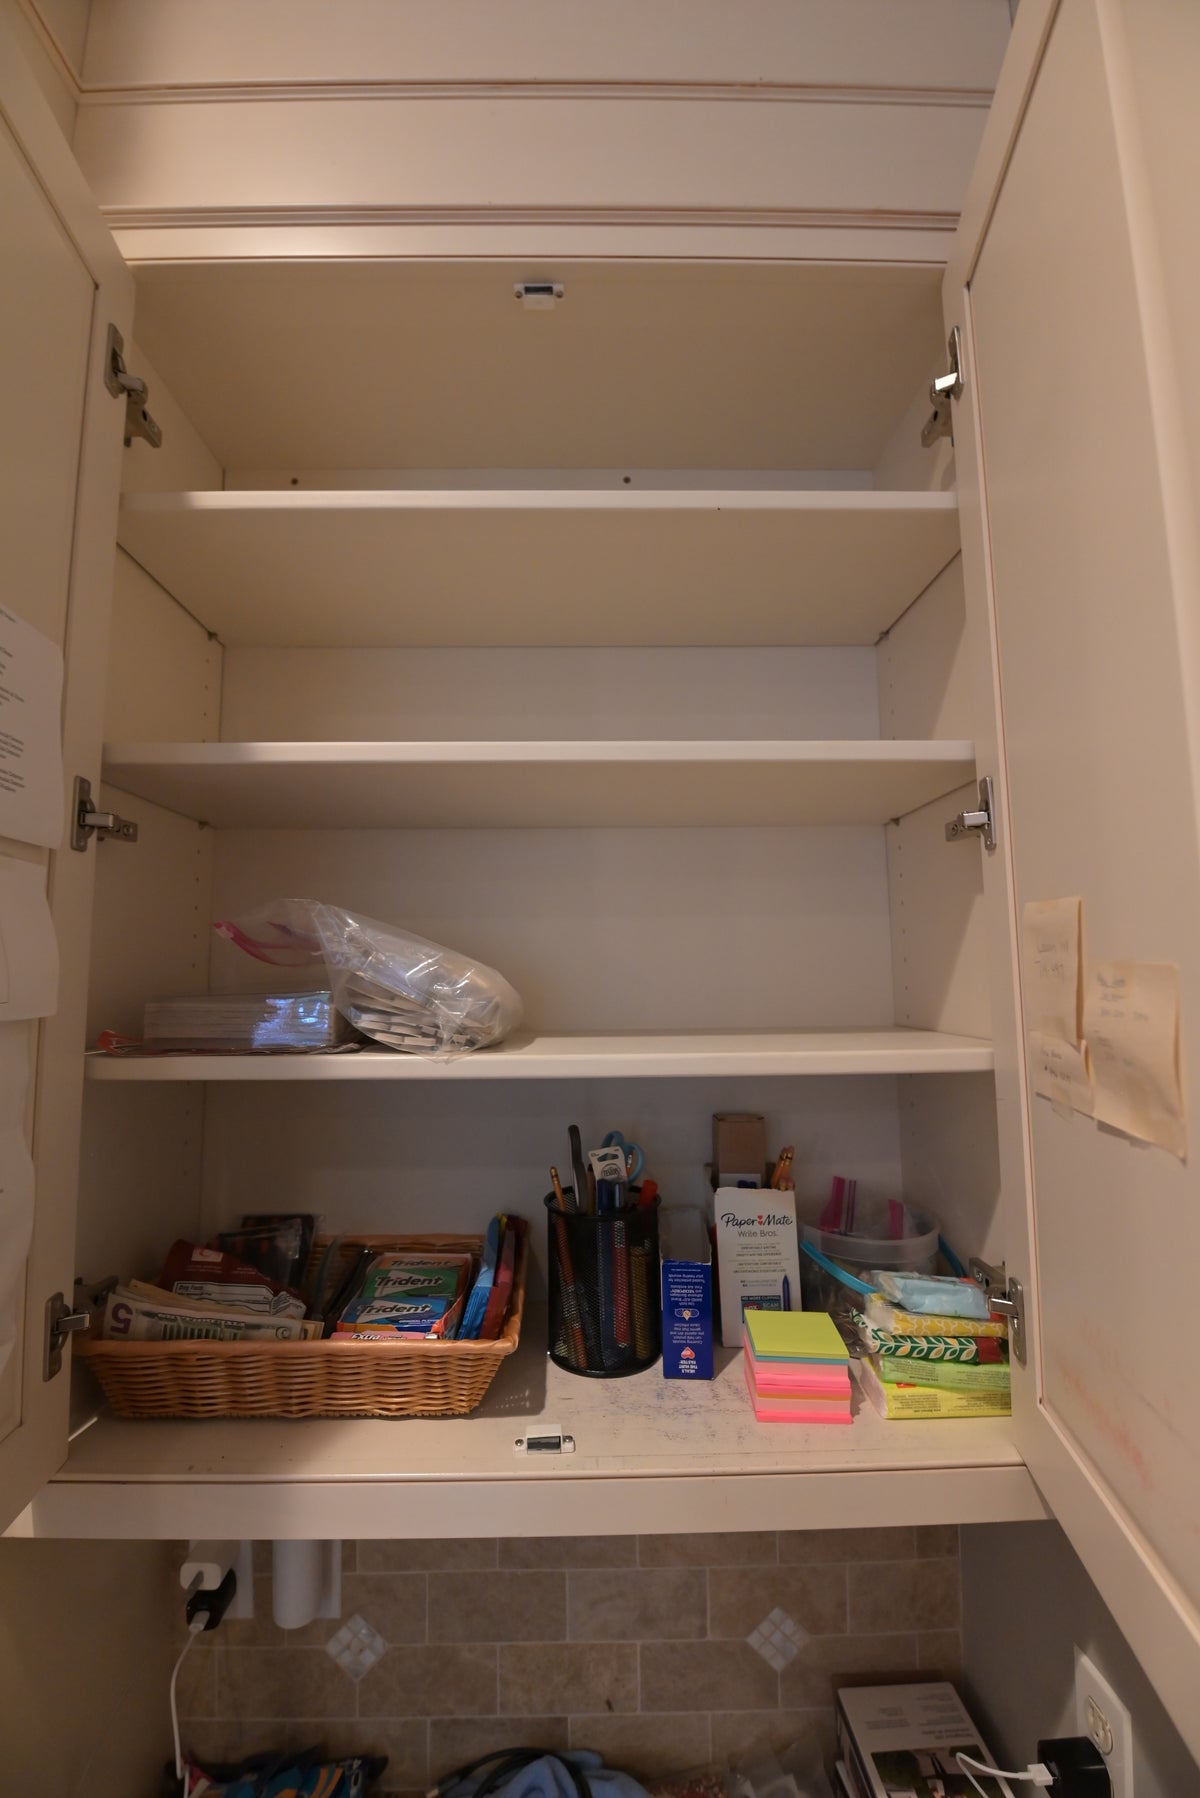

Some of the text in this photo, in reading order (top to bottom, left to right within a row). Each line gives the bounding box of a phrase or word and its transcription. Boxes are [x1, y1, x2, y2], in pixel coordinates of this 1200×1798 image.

[721, 1212, 793, 1228] Paper Mate
[738, 1230, 758, 1238] Write
[391, 1259, 451, 1267] Trident
[375, 1275, 444, 1286] Trident
[359, 1304, 432, 1314] Trident
[111, 1302, 133, 1334] 5
